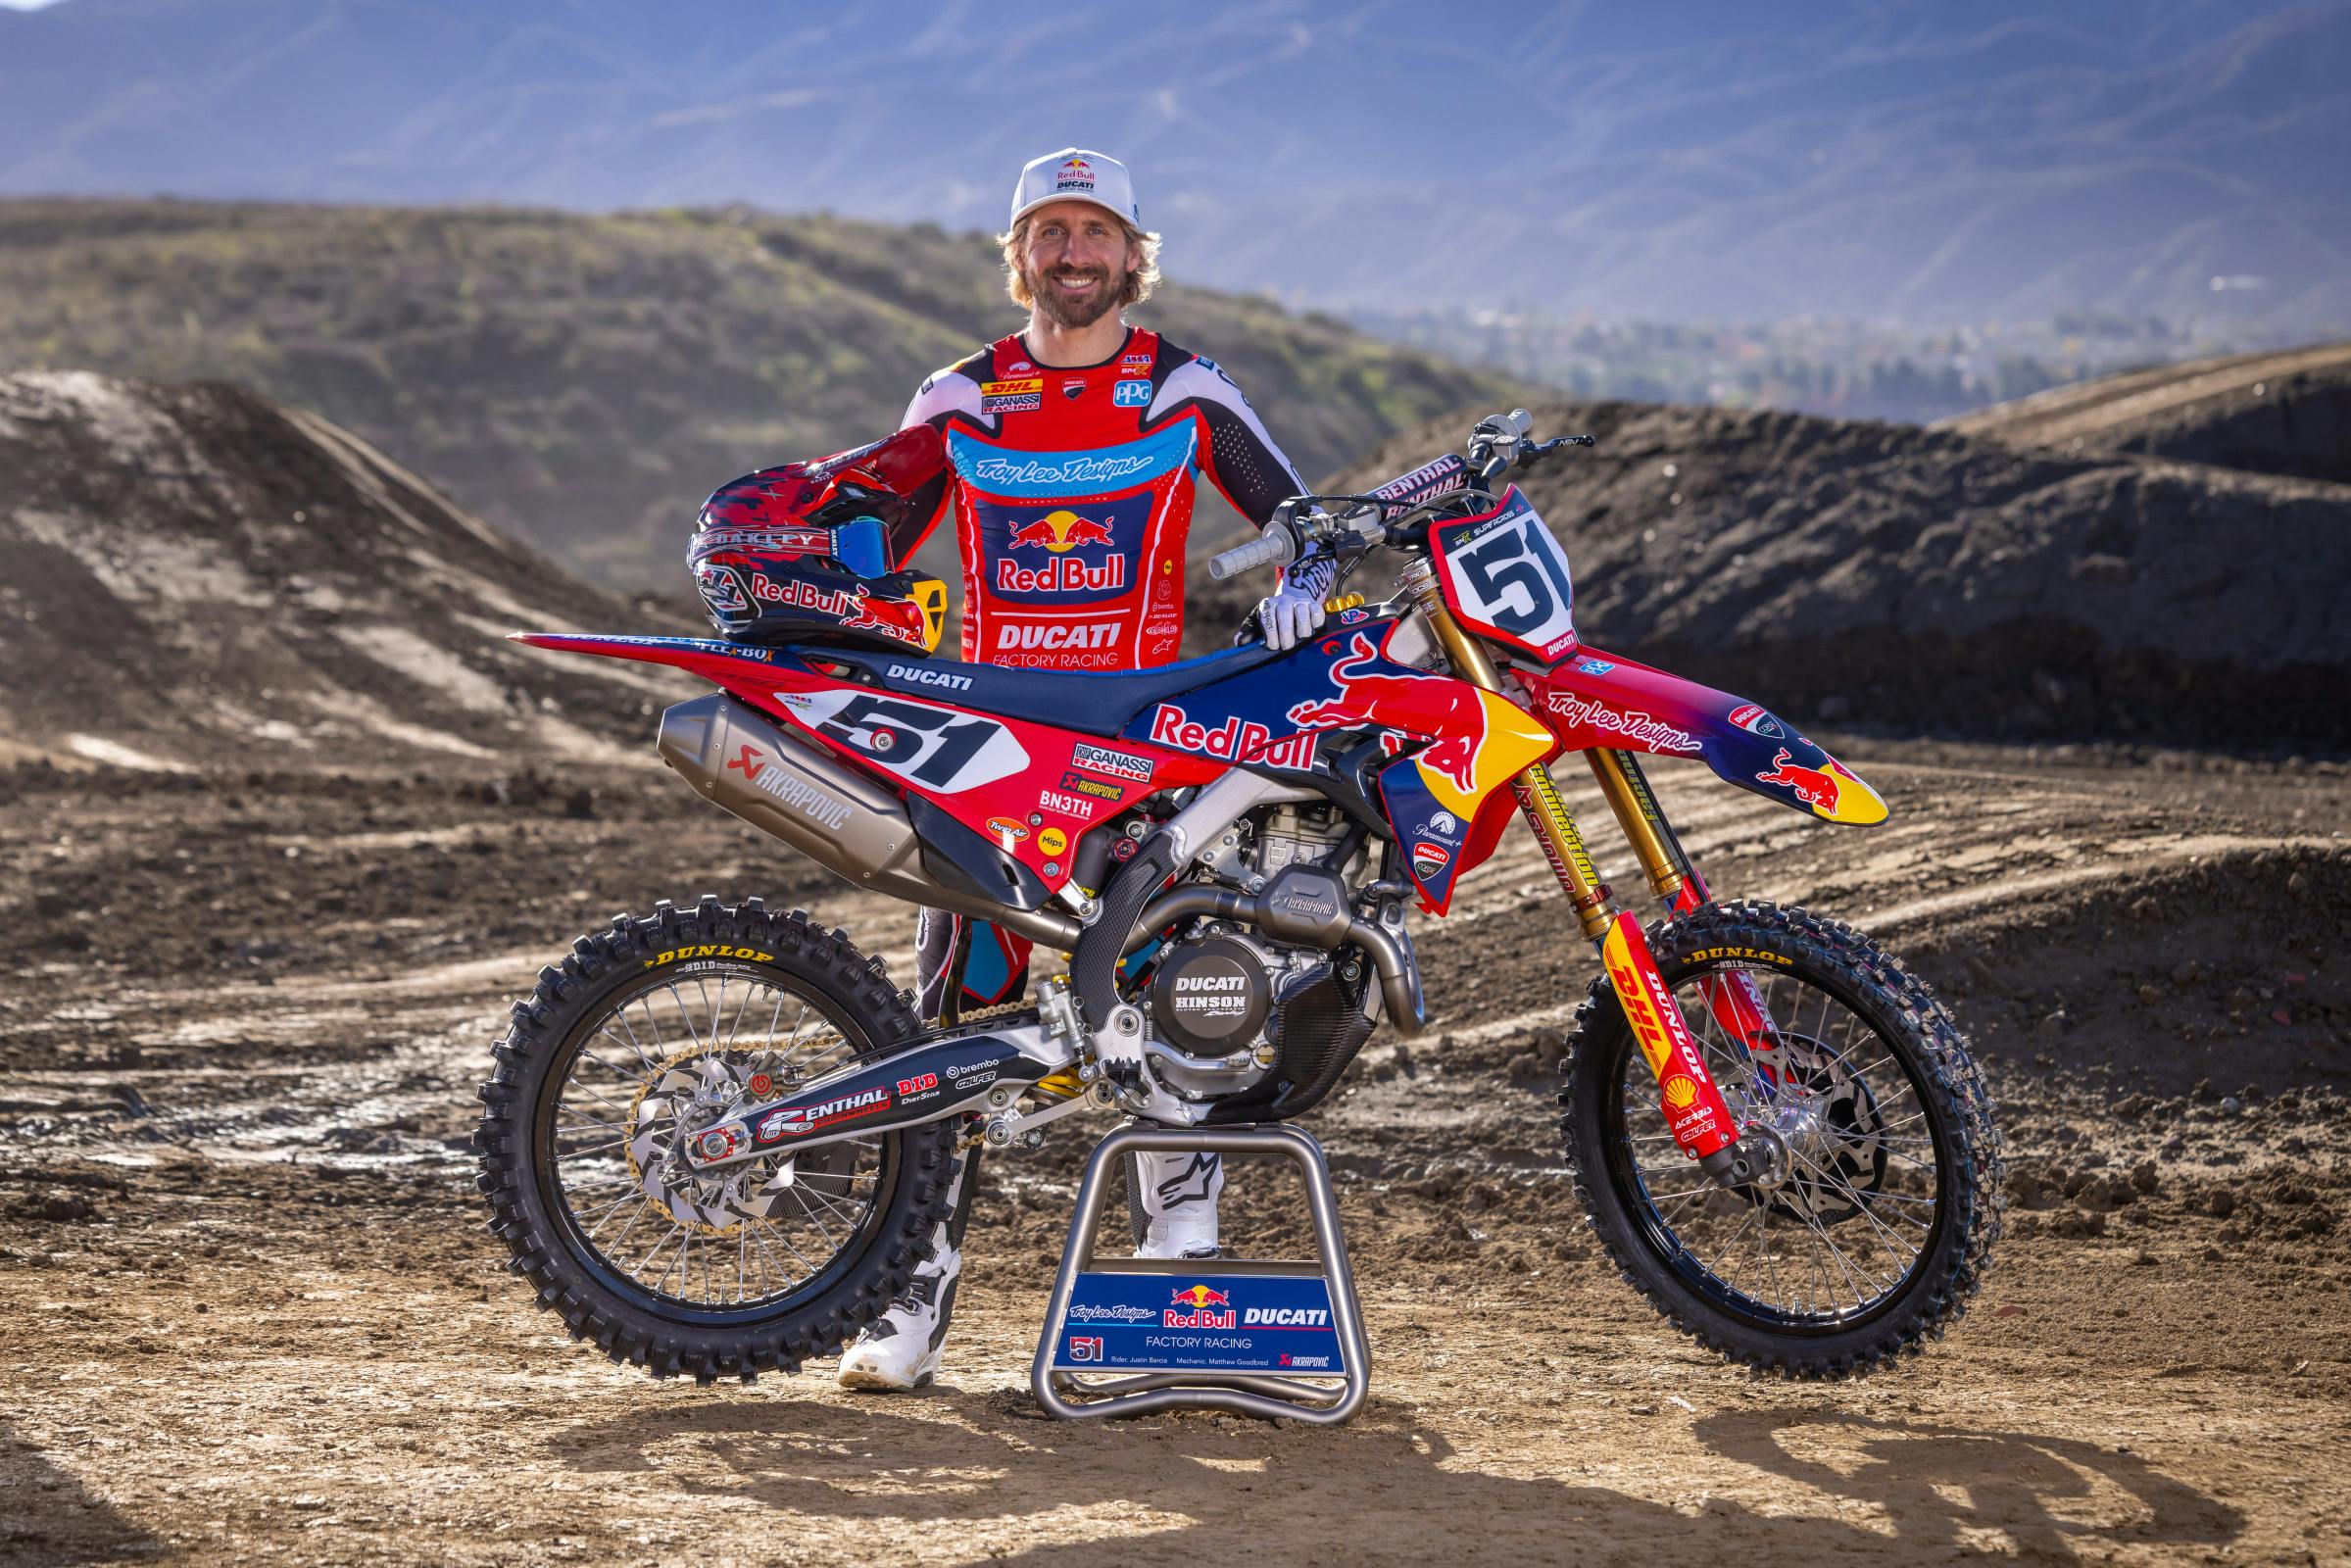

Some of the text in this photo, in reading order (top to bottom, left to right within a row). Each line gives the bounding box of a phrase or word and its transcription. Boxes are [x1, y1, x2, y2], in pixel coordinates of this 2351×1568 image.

[1056, 180, 1095, 189] DUCATI
[1057, 170, 1095, 180] Red Bull
[990, 381, 1032, 392] DHL
[1116, 383, 1150, 404] PPG
[983, 404, 1039, 413] RACING
[994, 394, 1040, 407] GANASSI
[976, 458, 1021, 485] Troy
[1020, 459, 1062, 482] Lee
[1061, 457, 1153, 483] Designs
[1375, 458, 1461, 501] RENTHAL
[998, 556, 1059, 591] Red
[1061, 554, 1125, 591] Bull
[1457, 518, 1571, 637] 51
[751, 572, 799, 606] Red
[798, 583, 849, 616] Bull
[997, 622, 1122, 650] DUCATI
[1547, 633, 1574, 656] DUCATI
[993, 652, 1118, 667] FACTORY RACING
[886, 663, 973, 691] DUCATI
[1547, 692, 1703, 753] Troy Lee Designs
[1734, 707, 1760, 724] DUCATI
[815, 694, 1003, 788] 51
[1149, 703, 1320, 771] Red Bull
[1074, 758, 1149, 781] RACING
[1090, 749, 1151, 773] GANASSI
[1040, 790, 1094, 817] BN3TH
[989, 820, 1028, 838] Twin Air
[1042, 836, 1063, 849] Mips
[1417, 846, 1445, 860] DUCATI
[656, 945, 775, 966] DUNLOP
[1691, 947, 1793, 965] DUNLOP
[1175, 976, 1246, 992] DUCATI
[1175, 996, 1246, 1008] HINSON
[1609, 965, 1663, 1052] DHL
[1645, 970, 1707, 1084] DUNLOP
[959, 1059, 999, 1074] brembo
[1675, 1105, 1713, 1129] ACERBIS
[1069, 1304, 1156, 1324] Troy Lee Designs
[1162, 1309, 1236, 1330] Red Bull
[1244, 1307, 1328, 1326] DUCATI
[1069, 1336, 1103, 1362] 51
[1146, 1336, 1252, 1349] FACTORY RACING
